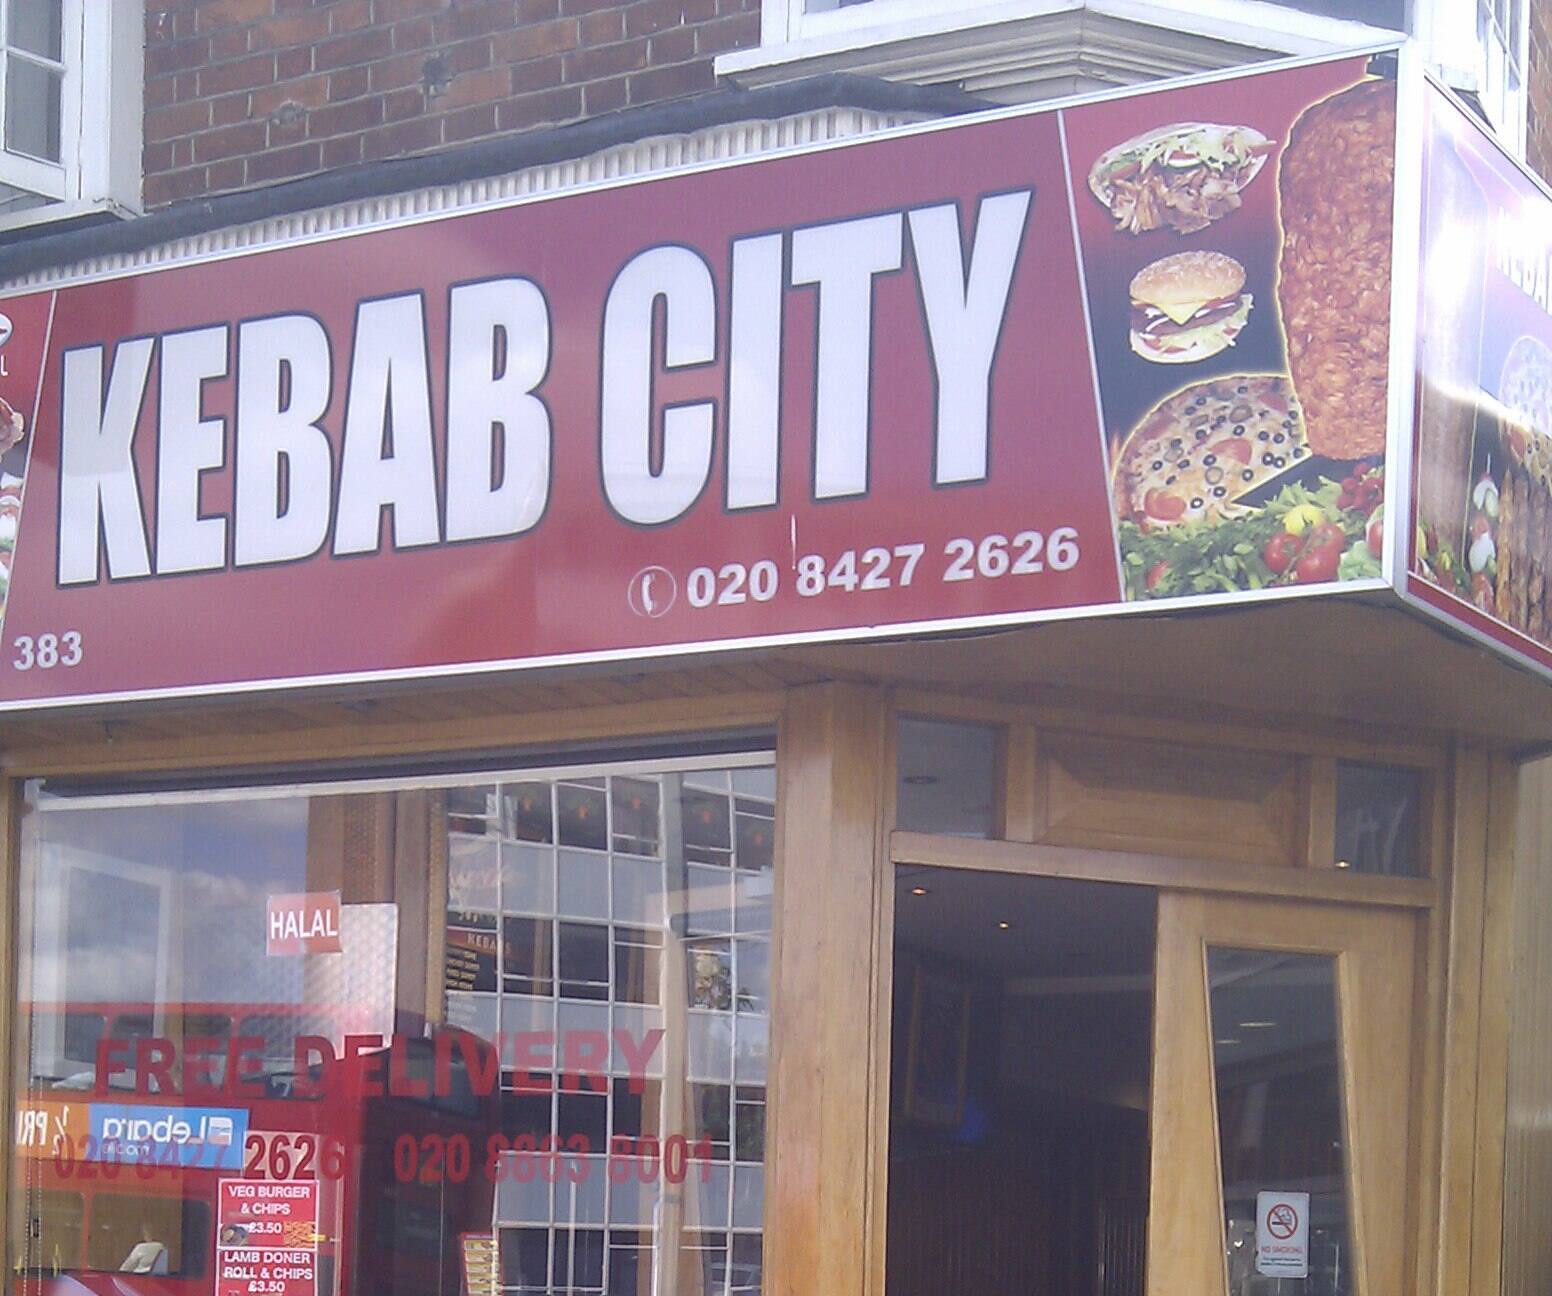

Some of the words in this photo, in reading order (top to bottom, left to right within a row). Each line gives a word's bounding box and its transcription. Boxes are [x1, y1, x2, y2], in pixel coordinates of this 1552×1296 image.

[56, 275, 553, 588] KEBAB
[600, 188, 1034, 527] CITY
[686, 561, 778, 608] 020
[795, 544, 925, 596] 8427
[942, 527, 1080, 582] 2626
[12, 630, 83, 671] 383
[271, 909, 338, 940] HALAL
[466, 931, 513, 953] KEBAS
[95, 1036, 268, 1098] FREE
[294, 1028, 665, 1098] DELIVERY
[54, 1134, 121, 1180] 020
[243, 1134, 348, 1182] 2626
[394, 1134, 470, 1184] 020
[484, 1134, 592, 1184] 8863
[607, 1133, 713, 1184] 8001
[229, 1186, 255, 1198] VEG
[258, 1186, 310, 1199] BURGER
[241, 1203, 250, 1214] &
[252, 1203, 291, 1215] CHIPS
[248, 1222, 282, 1234] £3.50
[224, 1252, 260, 1264] LAMB
[263, 1252, 310, 1264] DONER
[223, 1267, 257, 1279] ROLL
[261, 1268, 270, 1279] &
[273, 1268, 313, 1280] CHIPS
[248, 1281, 285, 1292] £3.50
